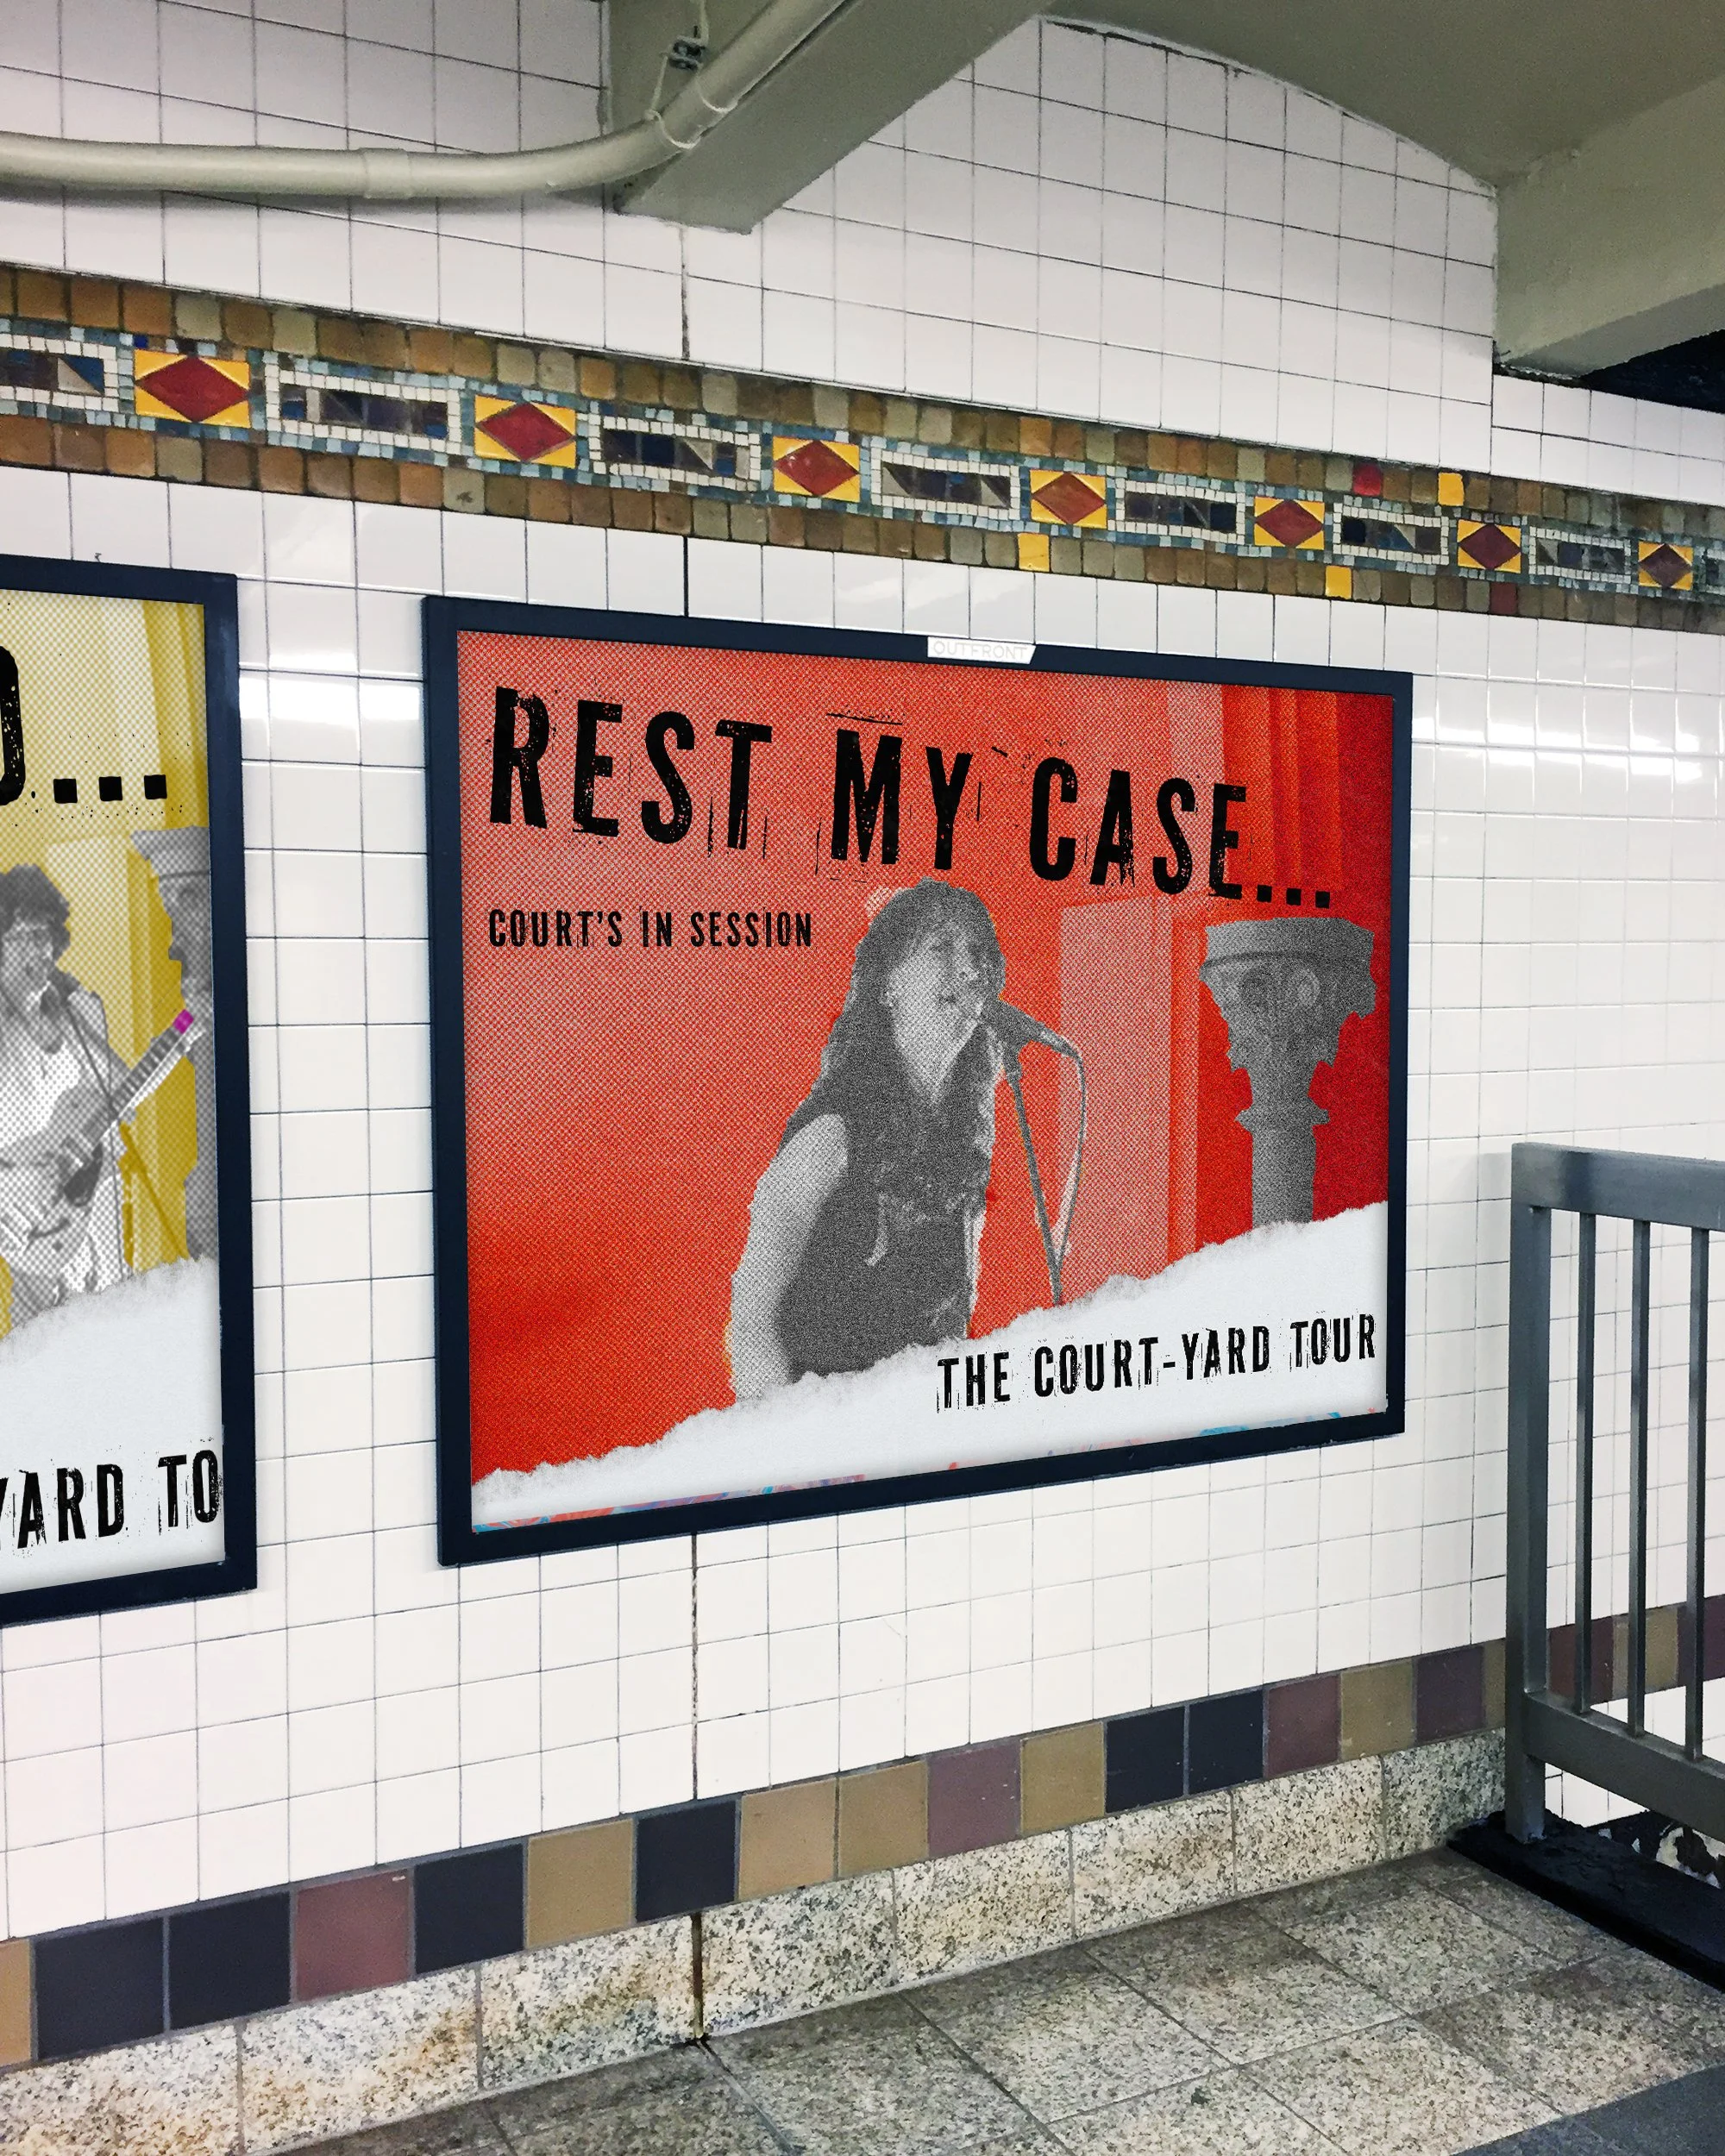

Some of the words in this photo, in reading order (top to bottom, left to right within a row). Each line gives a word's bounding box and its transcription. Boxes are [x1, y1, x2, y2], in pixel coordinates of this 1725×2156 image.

[933, 640, 1027, 660] OUTFRONT
[490, 686, 773, 850] REST
[831, 729, 974, 871] MY
[1030, 756, 1331, 910] CASE...
[488, 908, 623, 948] COURT'S
[641, 910, 672, 948] IN
[690, 912, 812, 948] SESSION
[938, 1351, 1011, 1409] THE
[1033, 1325, 1270, 1398] COURT-YARD
[1290, 1313, 1377, 1368] TOUR
[0, 1463, 125, 1550] ARD
[158, 1450, 218, 1528] TO
